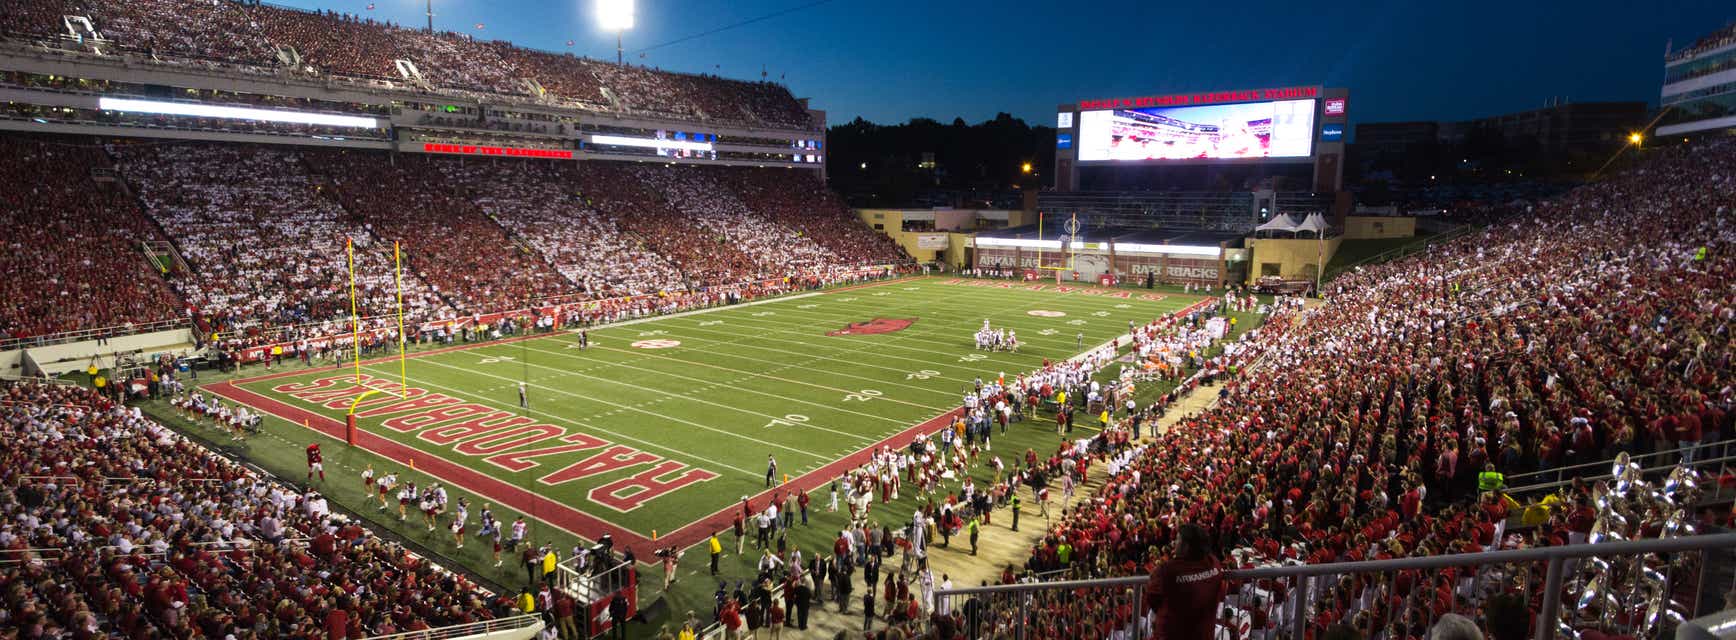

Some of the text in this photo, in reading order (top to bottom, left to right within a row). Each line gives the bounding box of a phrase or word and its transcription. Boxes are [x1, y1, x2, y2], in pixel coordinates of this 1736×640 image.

[1193, 90, 1260, 104] RAZORBACK
[1264, 87, 1317, 98] STADIUM
[272, 374, 721, 513] RAZORBACKS
[1175, 567, 1219, 584] ARKANSAS
